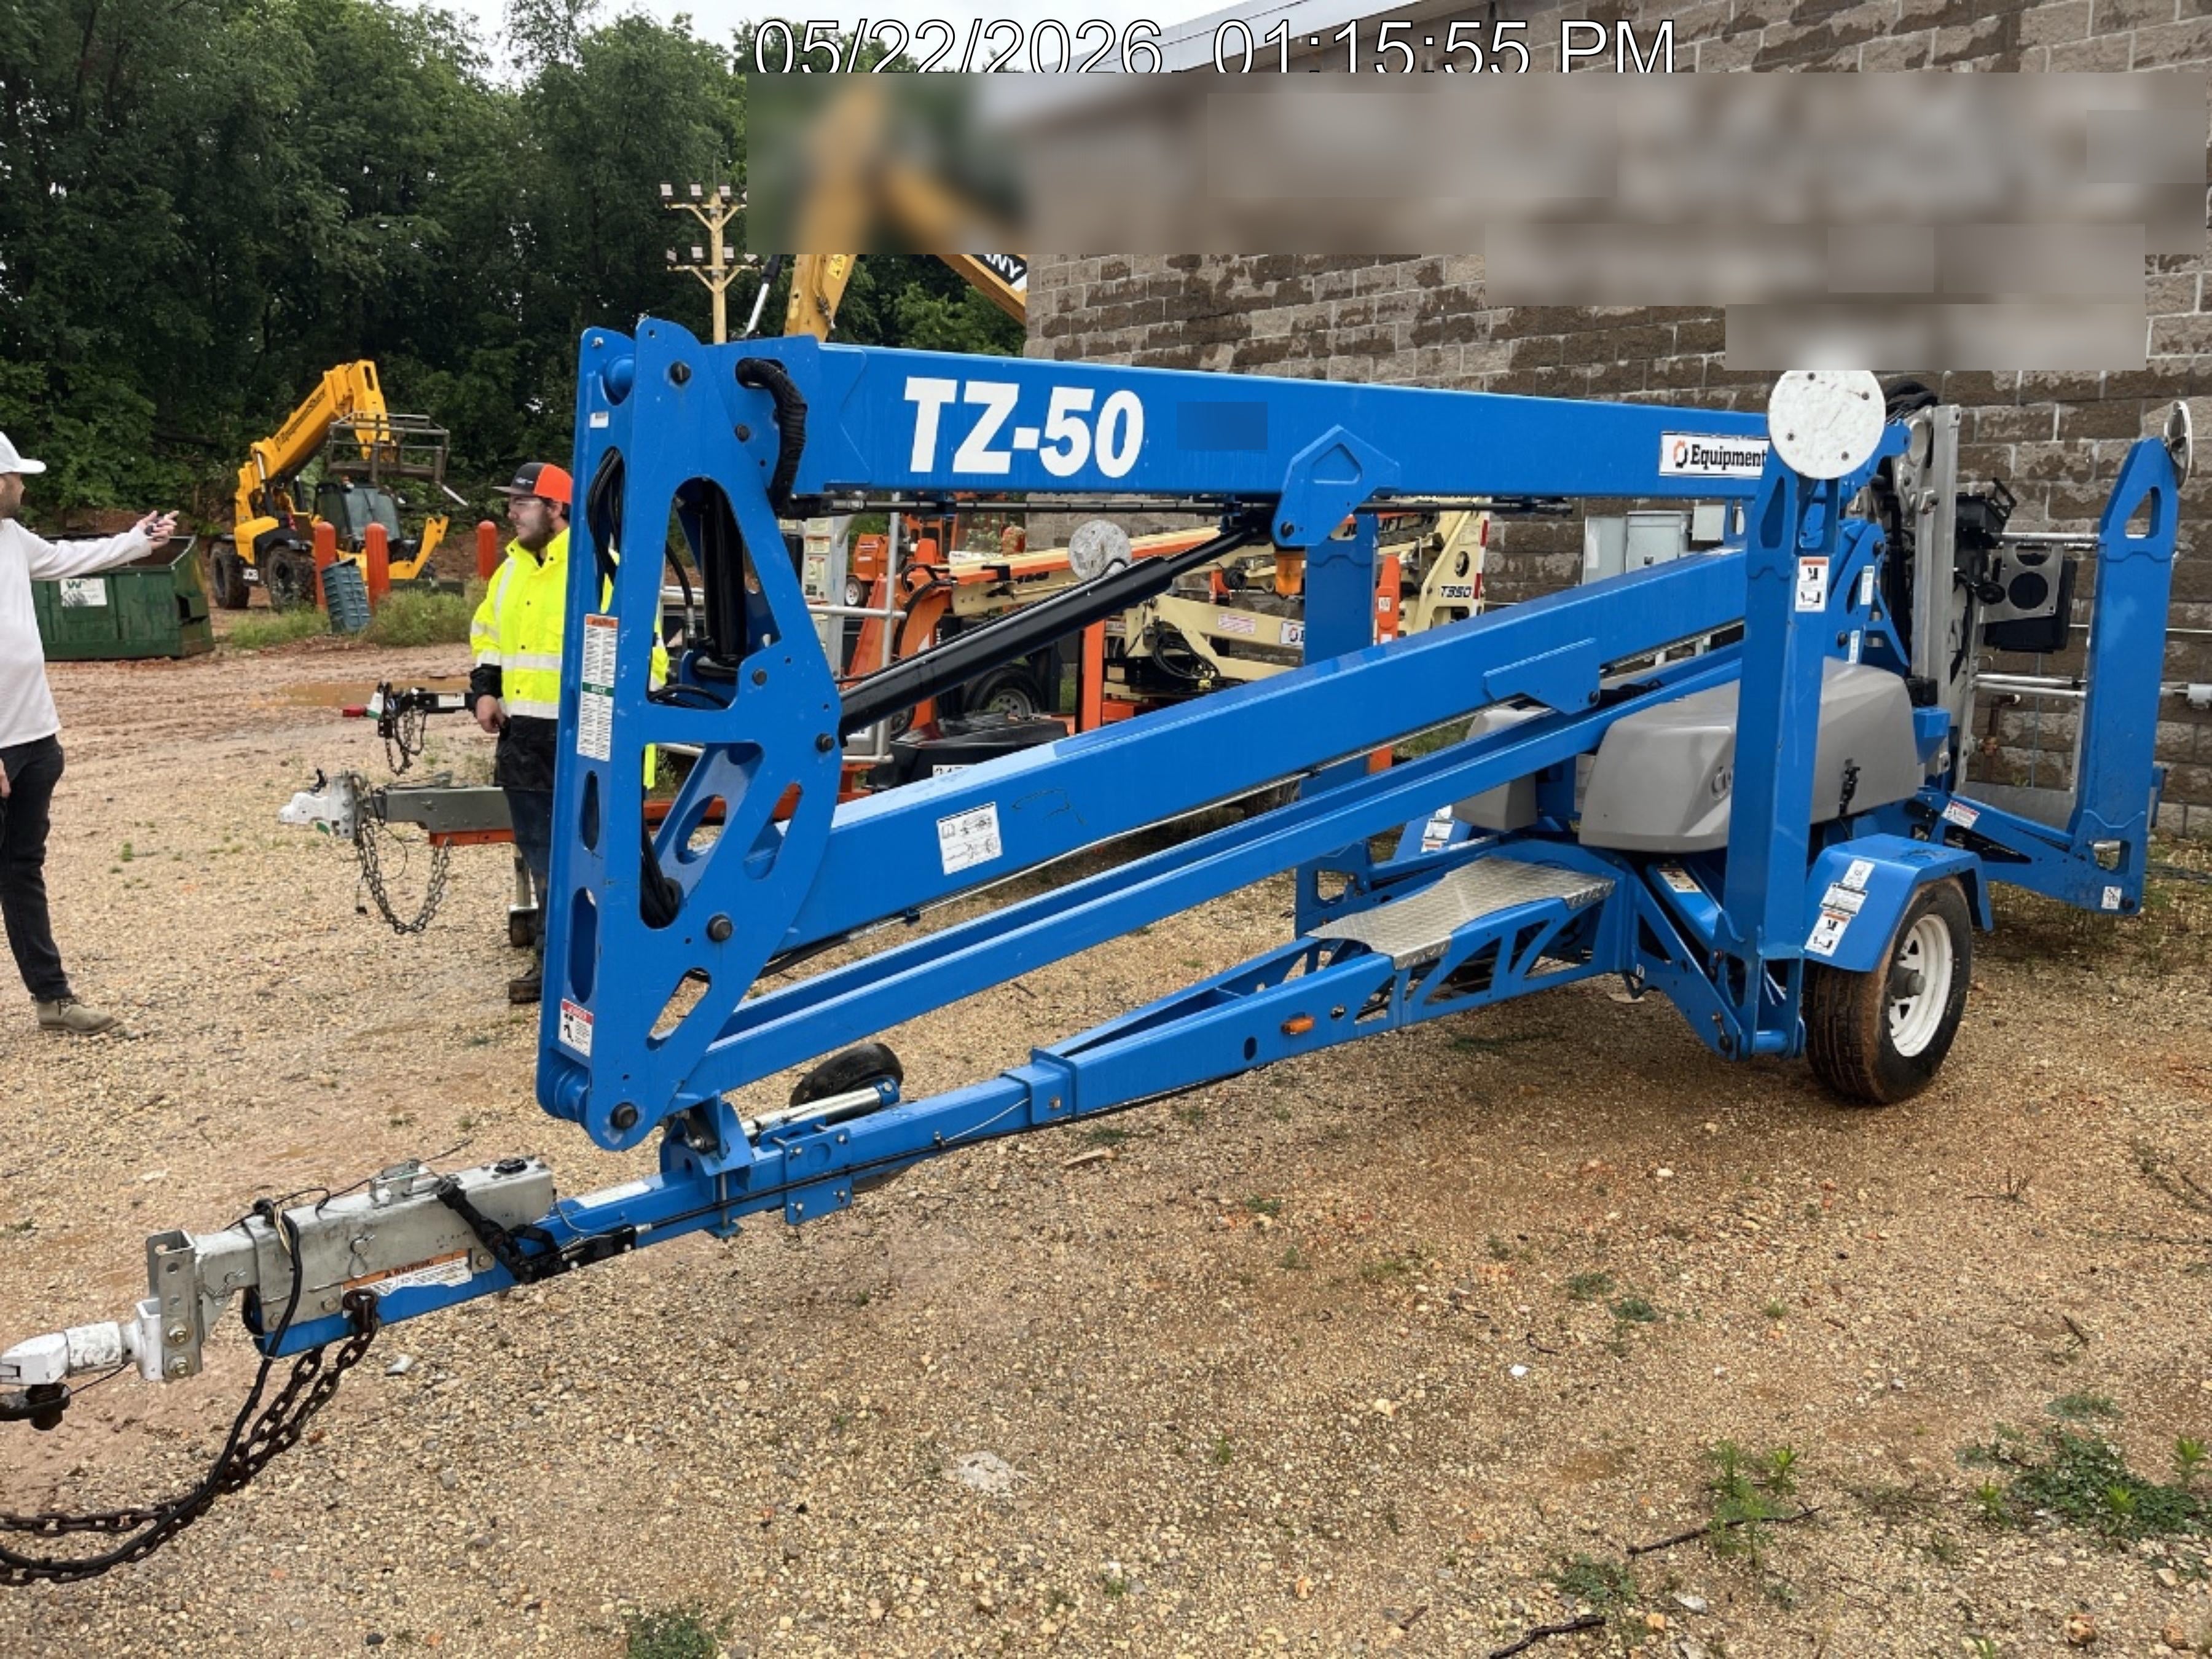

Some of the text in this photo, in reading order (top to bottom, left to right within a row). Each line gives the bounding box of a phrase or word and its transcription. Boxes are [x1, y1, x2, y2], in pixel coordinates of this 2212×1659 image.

[904, 377, 1144, 478] TZ-50
[1691, 444, 1767, 470] Equipment
[1441, 586, 1472, 598] T350
